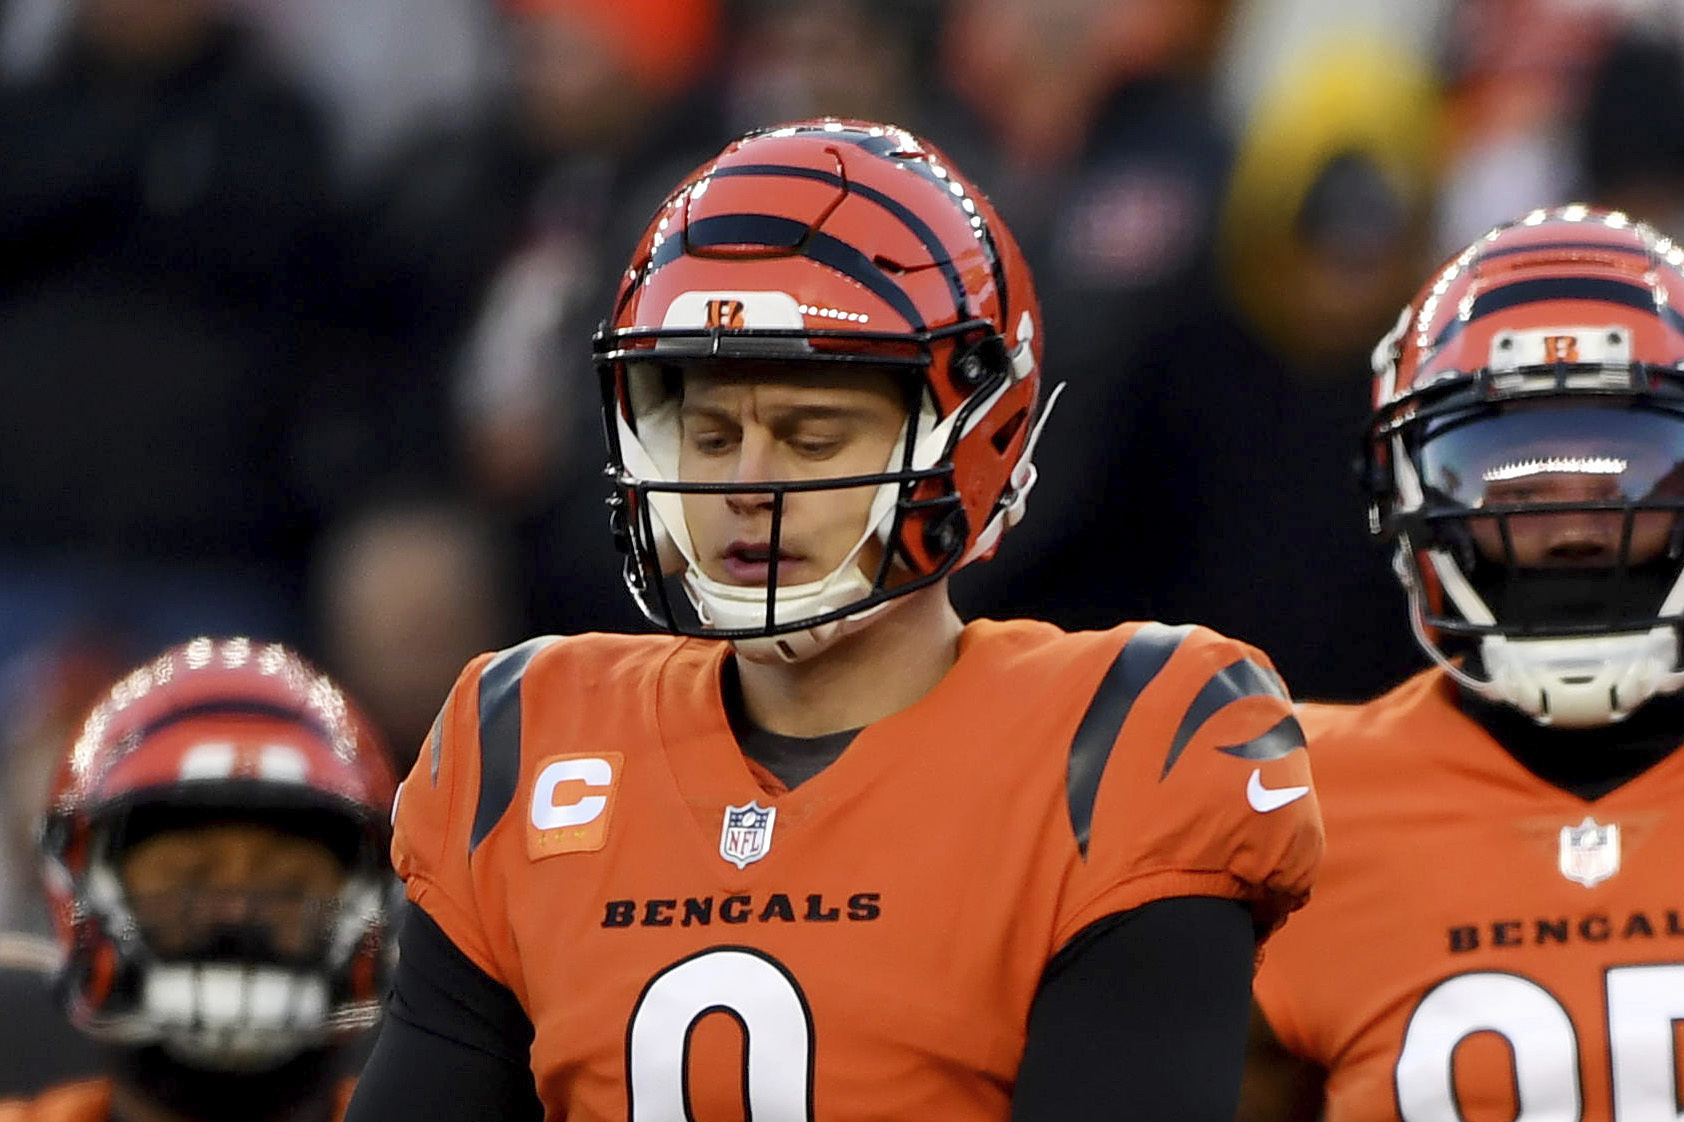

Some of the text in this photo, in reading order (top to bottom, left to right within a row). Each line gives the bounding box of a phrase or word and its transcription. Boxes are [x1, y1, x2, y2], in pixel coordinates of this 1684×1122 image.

[531, 758, 612, 830] C
[728, 830, 760, 855] NFL
[601, 893, 881, 928] BENGALS
